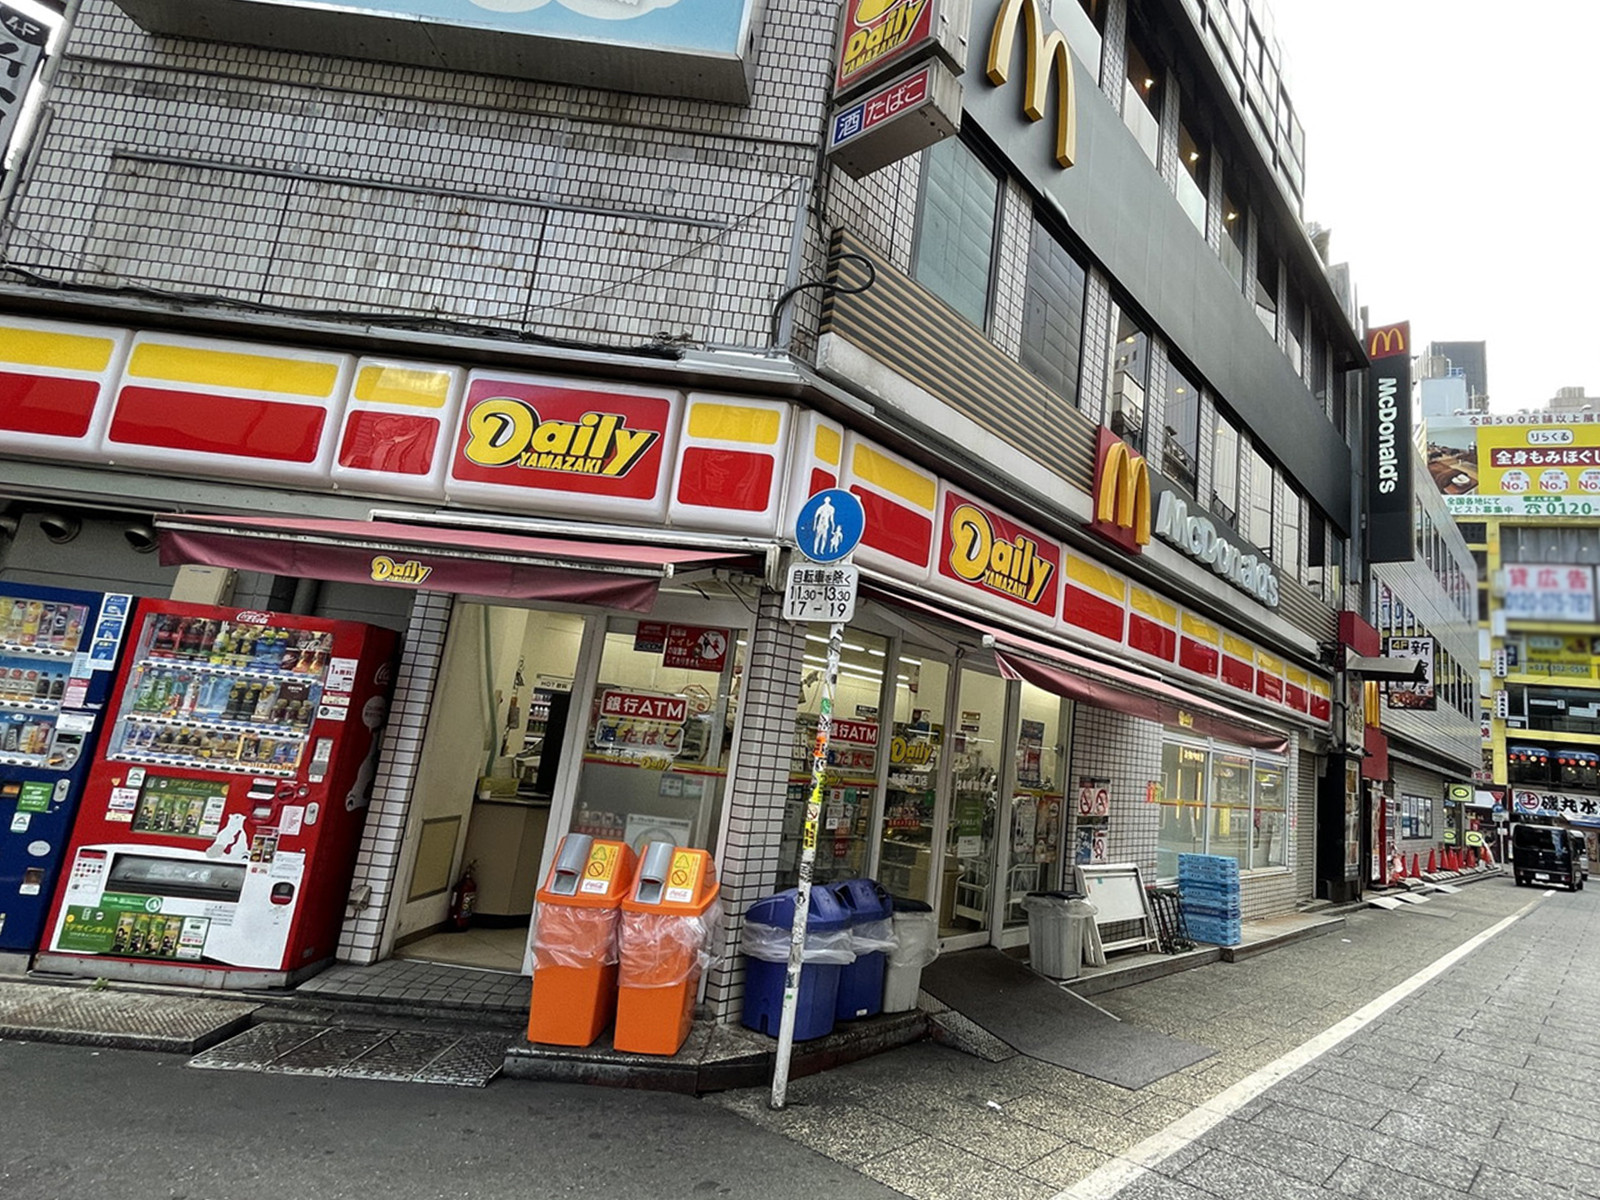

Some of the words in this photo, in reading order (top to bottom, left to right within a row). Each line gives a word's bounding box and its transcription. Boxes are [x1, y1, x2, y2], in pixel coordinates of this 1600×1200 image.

[5, 16, 41, 36] 4F
[843, 0, 927, 66] Daily
[843, 34, 902, 78] YAMAZAKI
[837, 110, 862, 140] 酒
[865, 78, 923, 126] たばこ
[1469, 414, 1600, 426] 全国500店舗以上展
[464, 397, 660, 478] Daily
[1378, 377, 1399, 494] McDonald's
[1530, 431, 1570, 442] りらくる
[518, 451, 602, 474] YAMAZAKI
[1501, 480, 1530, 491] No.1
[1540, 480, 1569, 491] No.1
[949, 503, 1055, 606] Daily
[1155, 490, 1279, 607] McDonald's
[371, 556, 433, 584] Daily
[793, 570, 852, 585] 自転車を除く
[984, 569, 1027, 599] YAMAZAKI
[790, 602, 807, 616] 17
[829, 603, 847, 617] 19
[1392, 640, 1408, 650] 4F
[1411, 640, 1430, 656] 新
[605, 695, 683, 719] 銀行ATM
[622, 725, 678, 748] たばこ
[891, 737, 933, 765] Daily
[1541, 796, 1600, 815] 磯丸水
